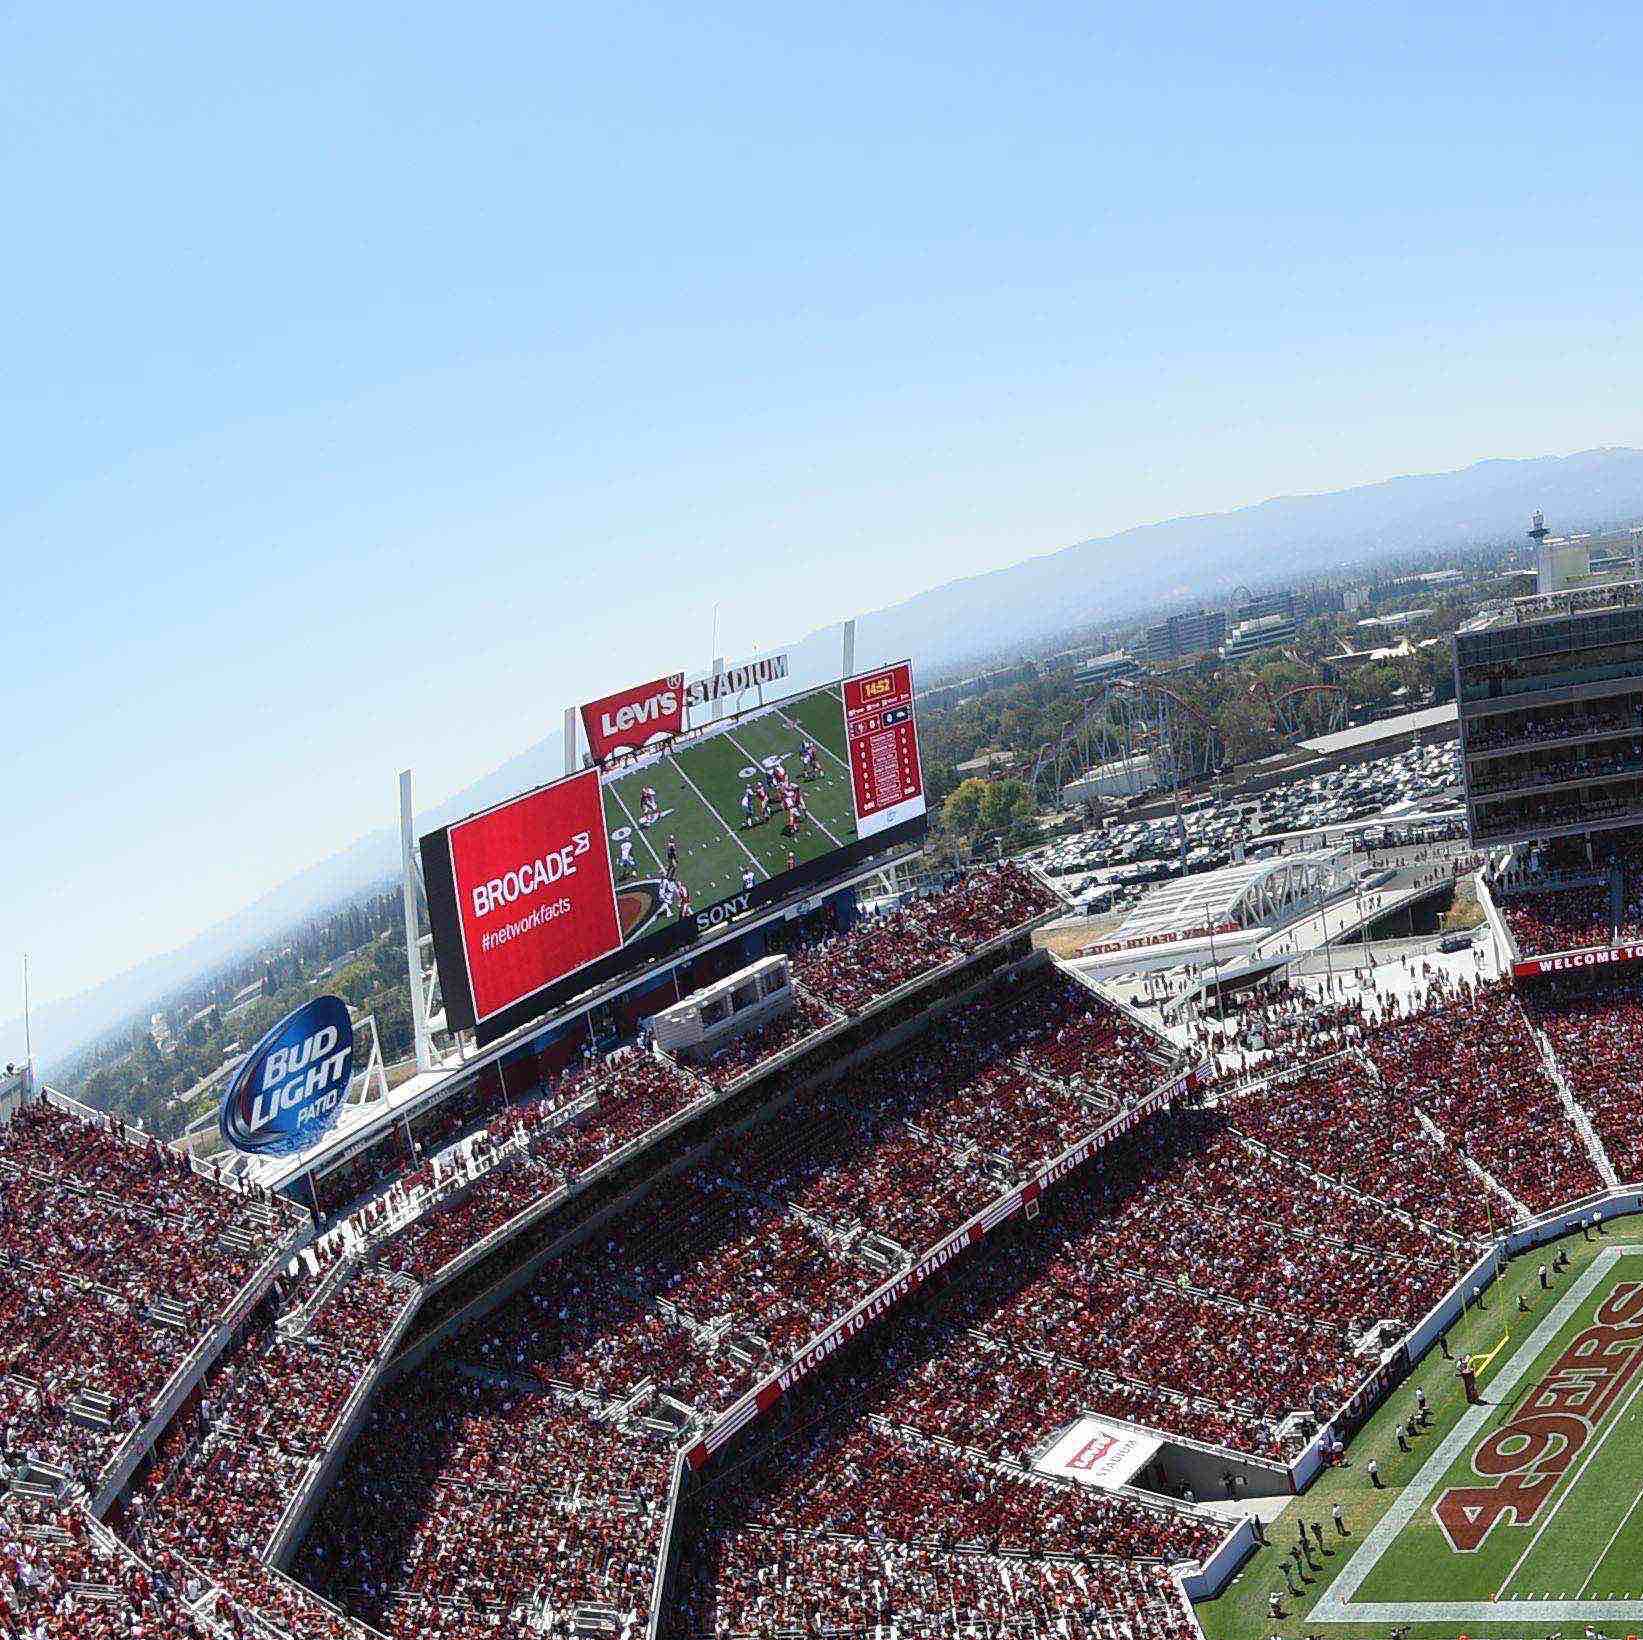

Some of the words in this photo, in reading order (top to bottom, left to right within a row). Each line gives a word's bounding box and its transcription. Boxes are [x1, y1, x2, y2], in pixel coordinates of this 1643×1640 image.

[687, 655, 790, 706] STADIUM
[471, 845, 578, 918] BROCADE
[480, 897, 571, 952] #networkfacts
[696, 895, 751, 930] SONY
[1539, 950, 1620, 972] WELCOME
[261, 1025, 339, 1093] BUD
[249, 1046, 352, 1134] LIGHT
[297, 1089, 338, 1128] PATIO
[1039, 1148, 1090, 1190] WELCOME
[1091, 1135, 1106, 1152] TO
[1146, 1080, 1188, 1116] STADIUM
[778, 1329, 845, 1391] WELCOME
[848, 1313, 865, 1336] TO
[916, 1231, 971, 1282] STADIUM
